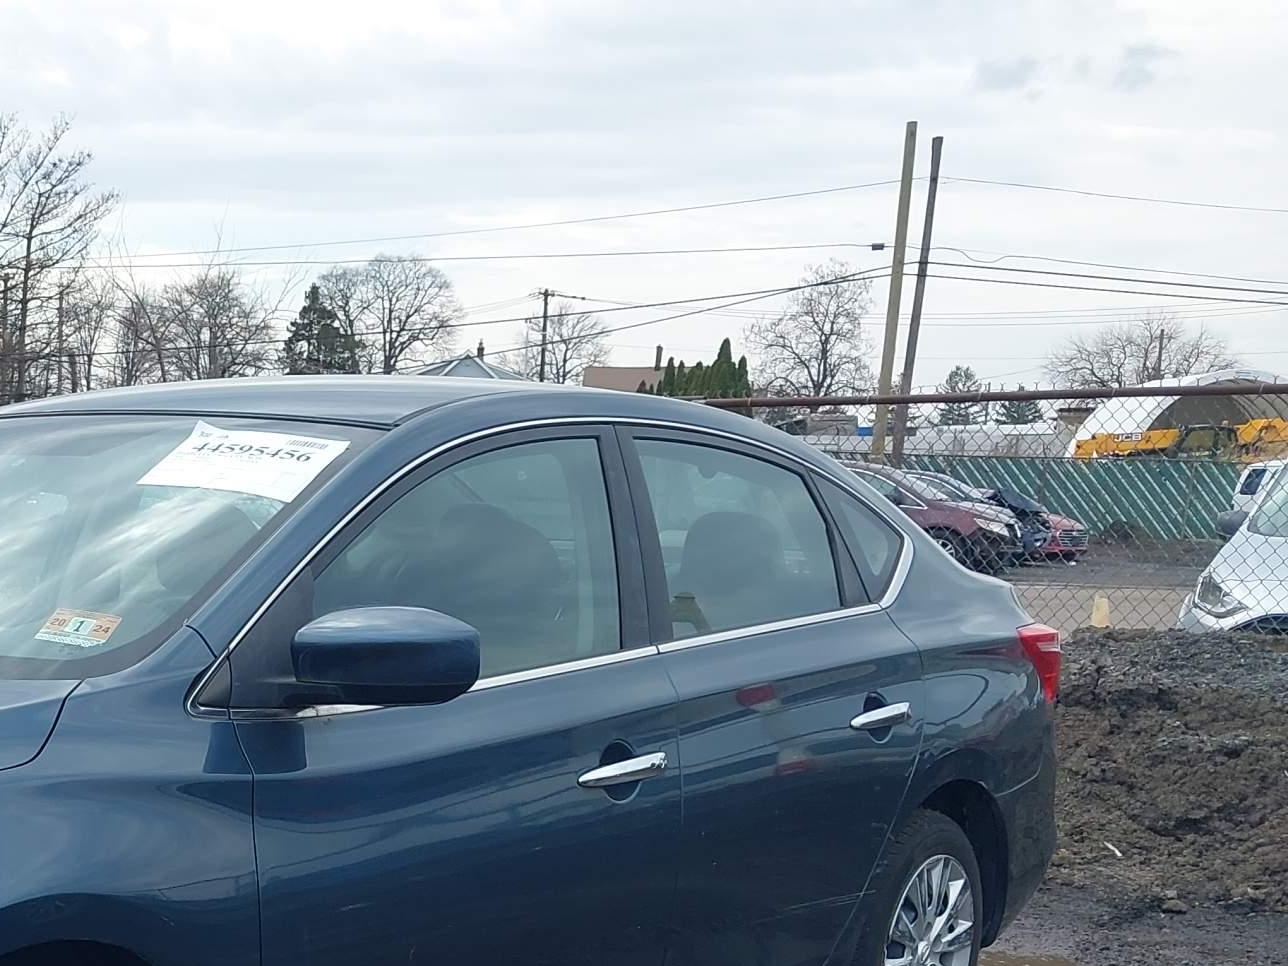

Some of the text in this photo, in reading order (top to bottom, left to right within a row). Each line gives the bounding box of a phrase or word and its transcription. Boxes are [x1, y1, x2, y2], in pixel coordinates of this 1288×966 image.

[1113, 433, 1142, 442] JCB
[193, 441, 315, 463] 44595456
[50, 617, 111, 634] 20 1 24
